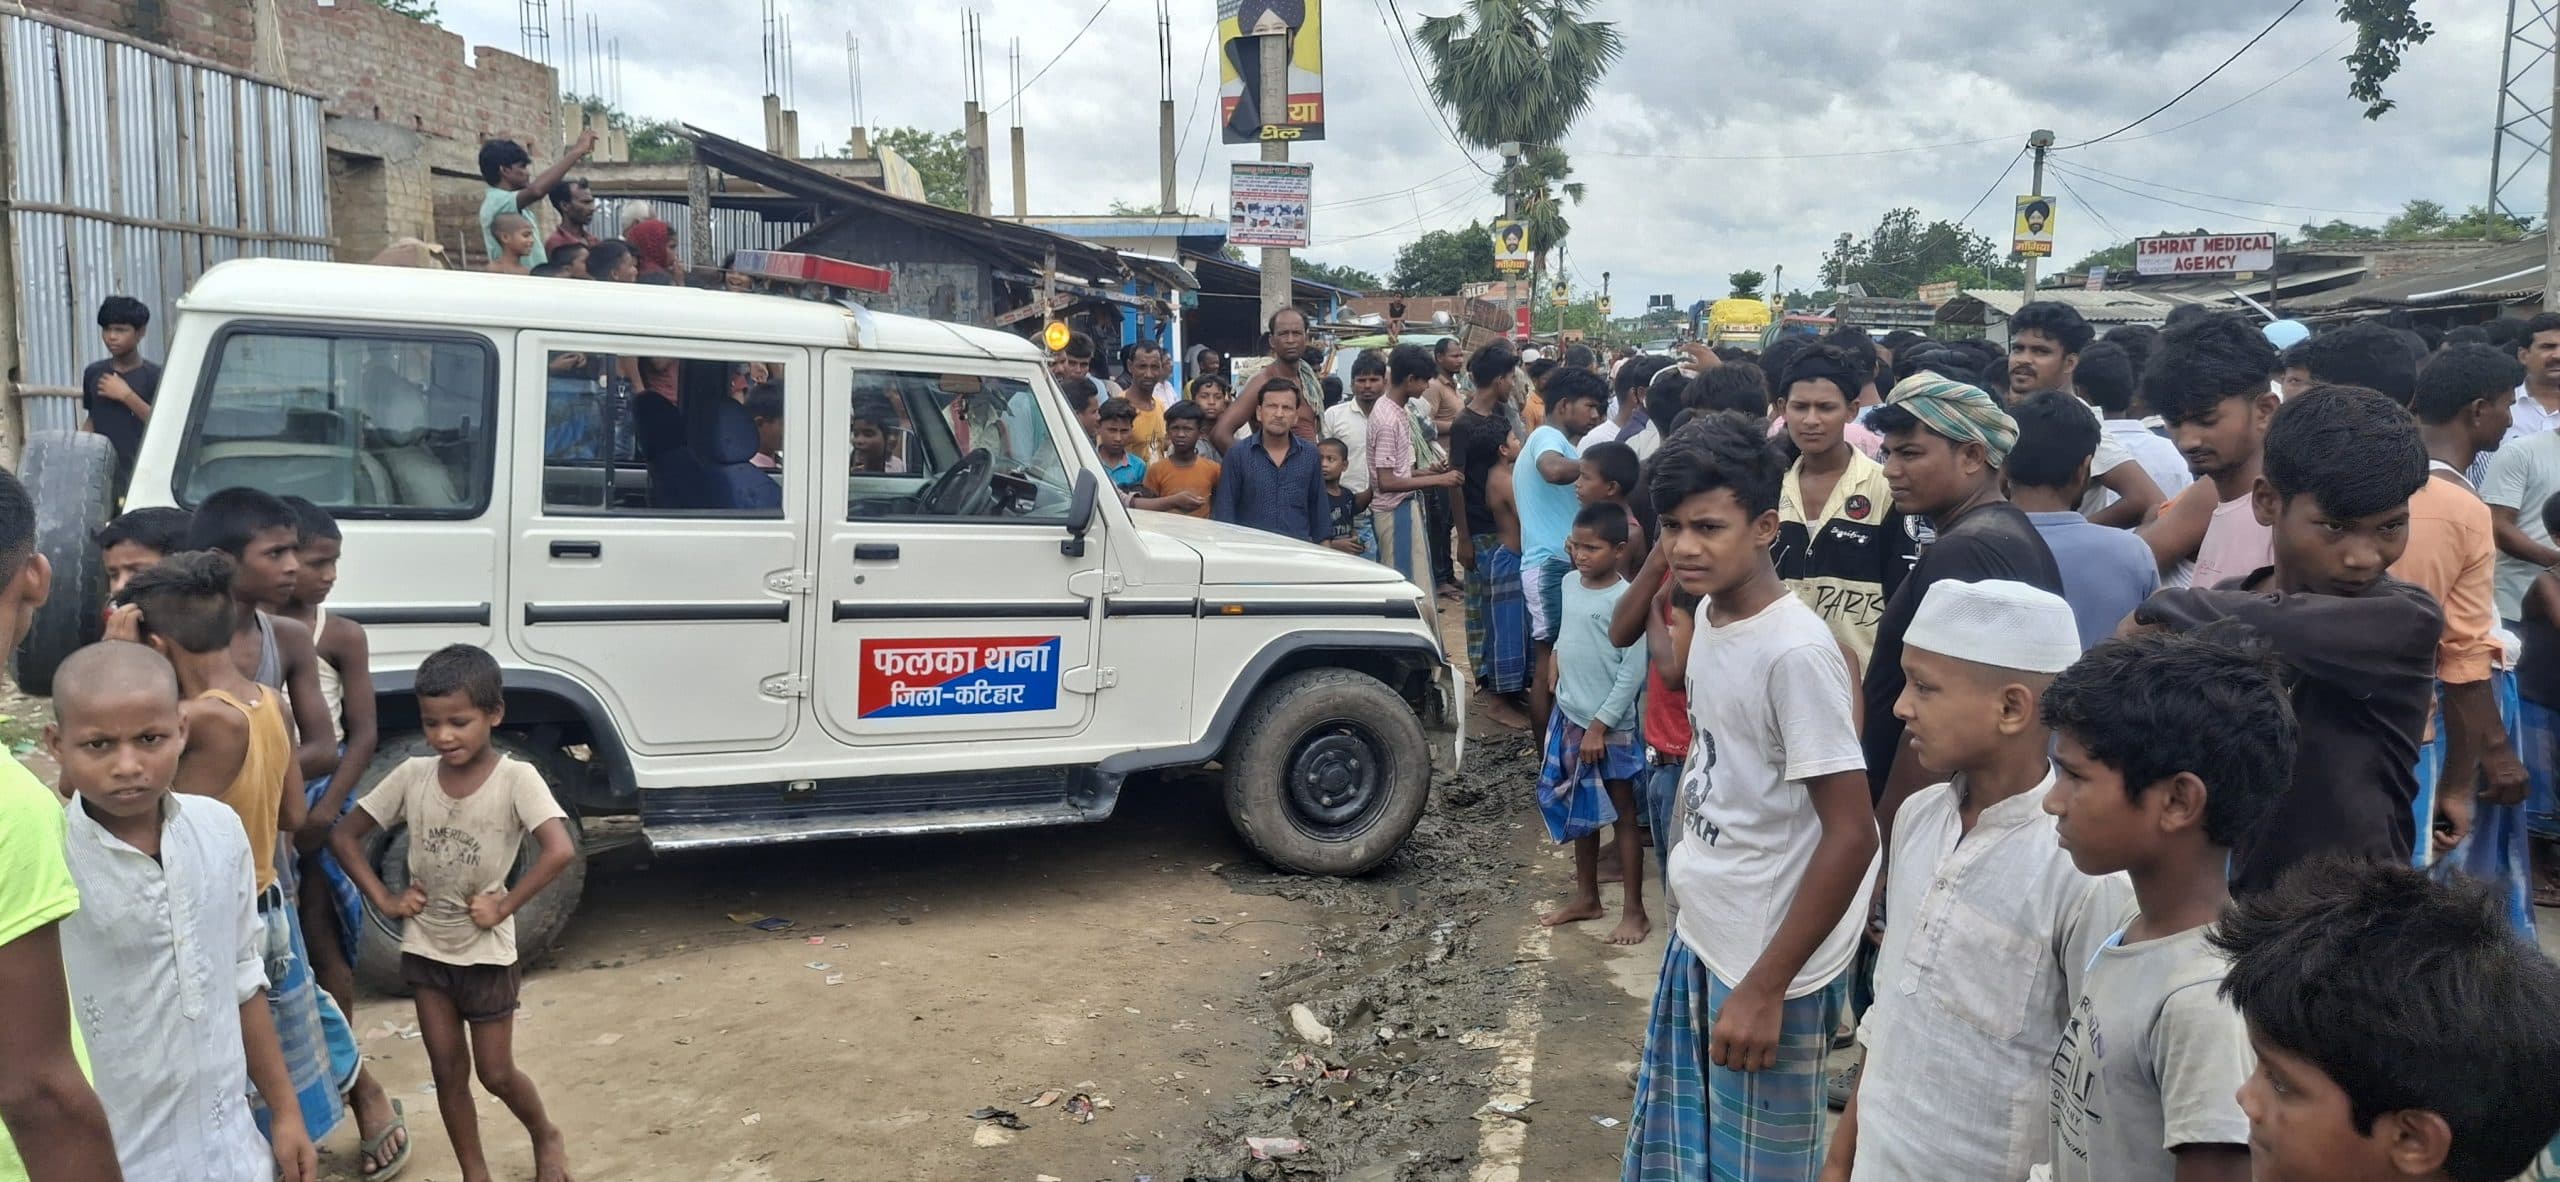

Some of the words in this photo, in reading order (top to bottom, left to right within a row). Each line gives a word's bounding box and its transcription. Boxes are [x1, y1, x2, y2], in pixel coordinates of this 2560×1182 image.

[2139, 238, 2196, 255] ISHRAT
[2203, 236, 2273, 253] MEDICAL
[1814, 585, 1885, 627] PARIS
[873, 646, 978, 676] फलका
[984, 645, 1051, 673] थाना
[890, 679, 1026, 707] जिला-कटिहार
